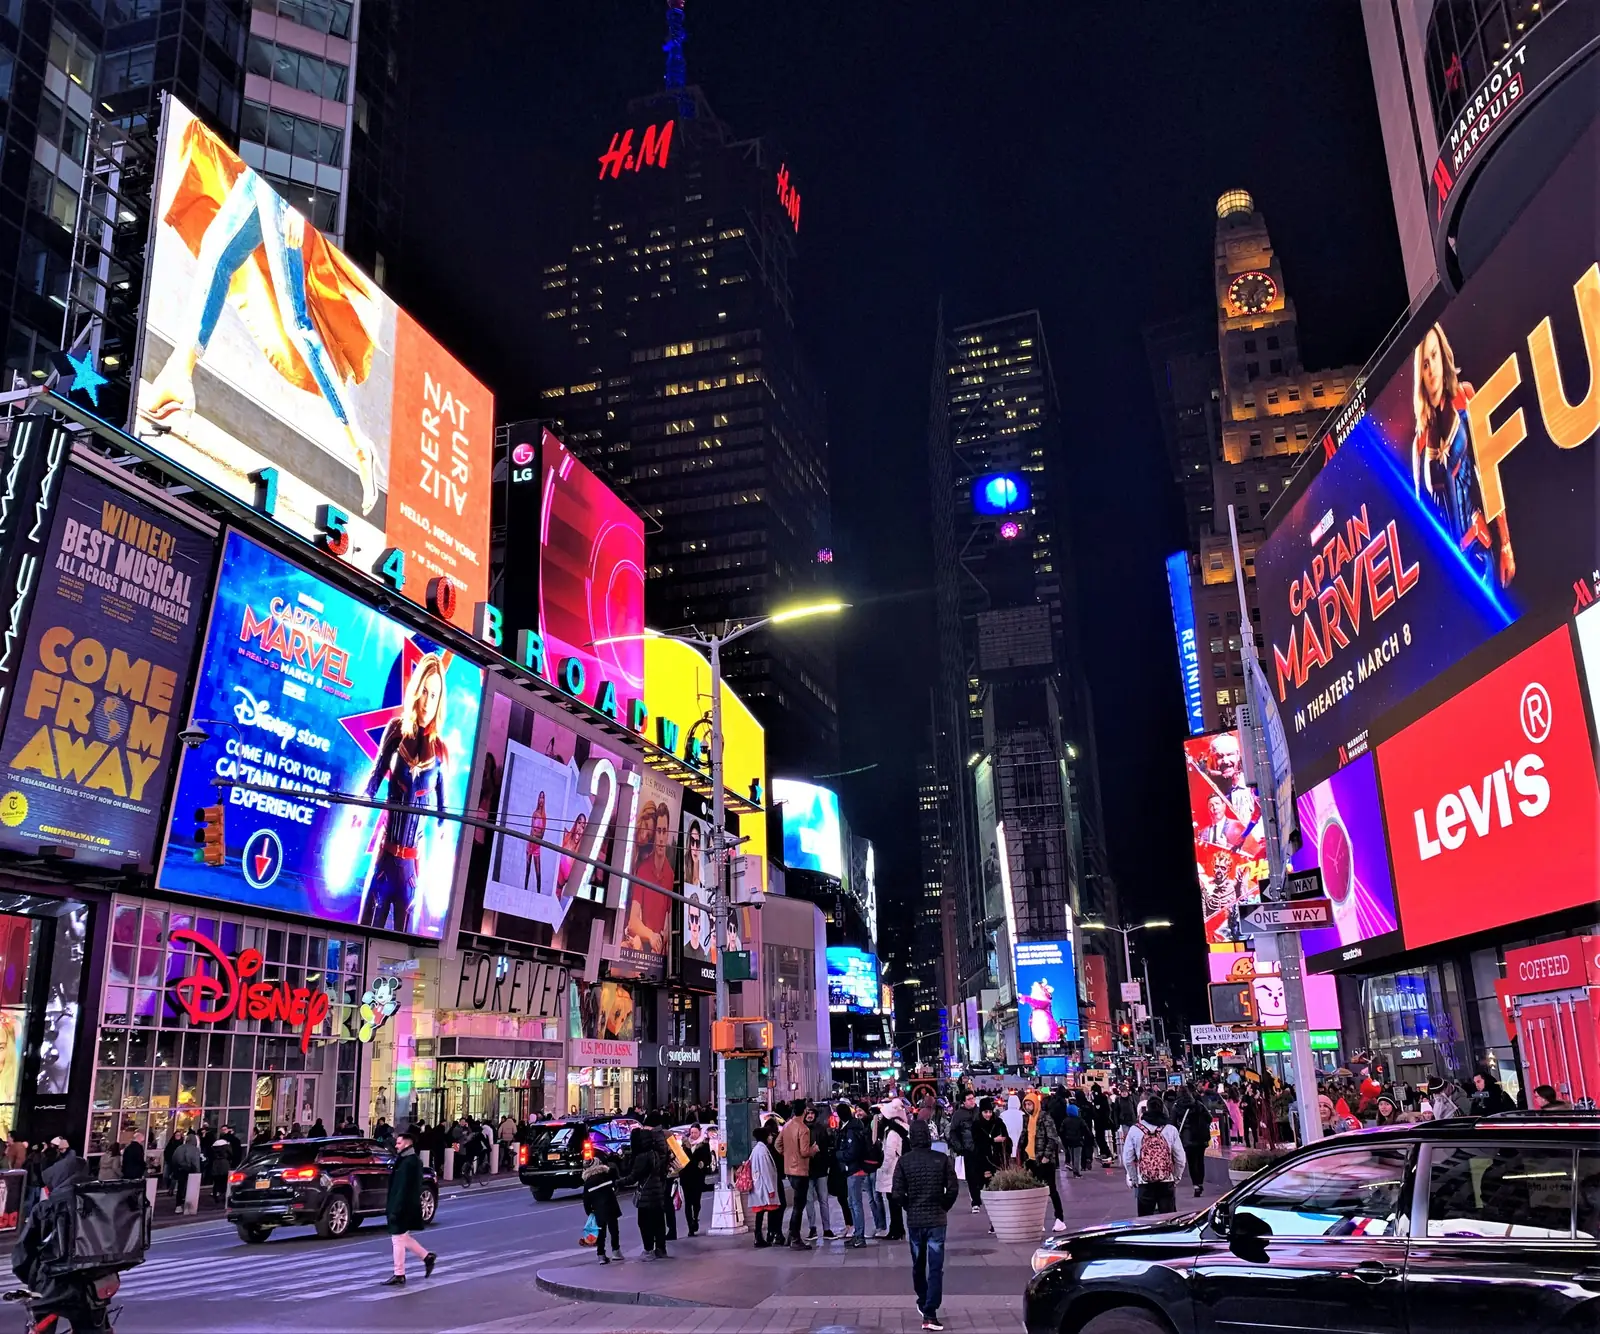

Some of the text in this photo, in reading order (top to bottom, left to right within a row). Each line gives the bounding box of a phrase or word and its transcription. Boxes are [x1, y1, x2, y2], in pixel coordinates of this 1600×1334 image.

[1450, 45, 1527, 151] MARRIOTT
[1454, 80, 1520, 171] MARQUIS
[598, 119, 674, 180] H&M
[777, 163, 801, 234] H&M
[1335, 387, 1367, 434] MARRIOTT
[1337, 406, 1366, 447] MARQUIS
[513, 468, 533, 483] LG
[101, 500, 176, 563] WINNER!
[400, 501, 432, 535] HELLO,
[433, 524, 454, 548] NEW
[61, 517, 192, 608] BEST MUSICAL
[1288, 503, 1371, 617] CAPTAIN
[55, 552, 76, 575] ALL
[77, 562, 119, 592] ACROSS
[119, 581, 150, 608] NORTH
[150, 595, 190, 625] AMERICA
[1273, 519, 1420, 703] MARVEL
[270, 596, 338, 643] CAPTAIN
[39, 626, 178, 713] COME
[238, 647, 246, 656] IN
[280, 662, 315, 685] MARCH
[240, 603, 354, 689] MARVEL
[1294, 623, 1413, 734] IN THEATERS MARCH 8
[24, 669, 170, 757] FROM
[233, 685, 297, 749] Disney
[297, 727, 331, 753] store
[9, 724, 161, 801] AWAY
[215, 757, 279, 788] CAPTAIN
[225, 739, 331, 786] COME IN FOR YOUR
[7, 773, 152, 815] THE REMARKABLE TRUE STORY NOW ON BROADWAY
[229, 786, 315, 826] EXPERIENCE
[38, 824, 112, 846] COMEFROMAWAY.COM
[573, 758, 641, 910] 21
[1293, 878, 1314, 892] WAY
[1253, 908, 1320, 924] ONE WAY
[456, 951, 567, 1018] FOREVER
[701, 967, 716, 980] HOUSE
[1519, 954, 1570, 981] COFFEED
[581, 1041, 633, 1057] U.S. POLO ASSN.
[1231, 1031, 1250, 1040] MOVING
[484, 1058, 544, 1080] FOREVER 21
